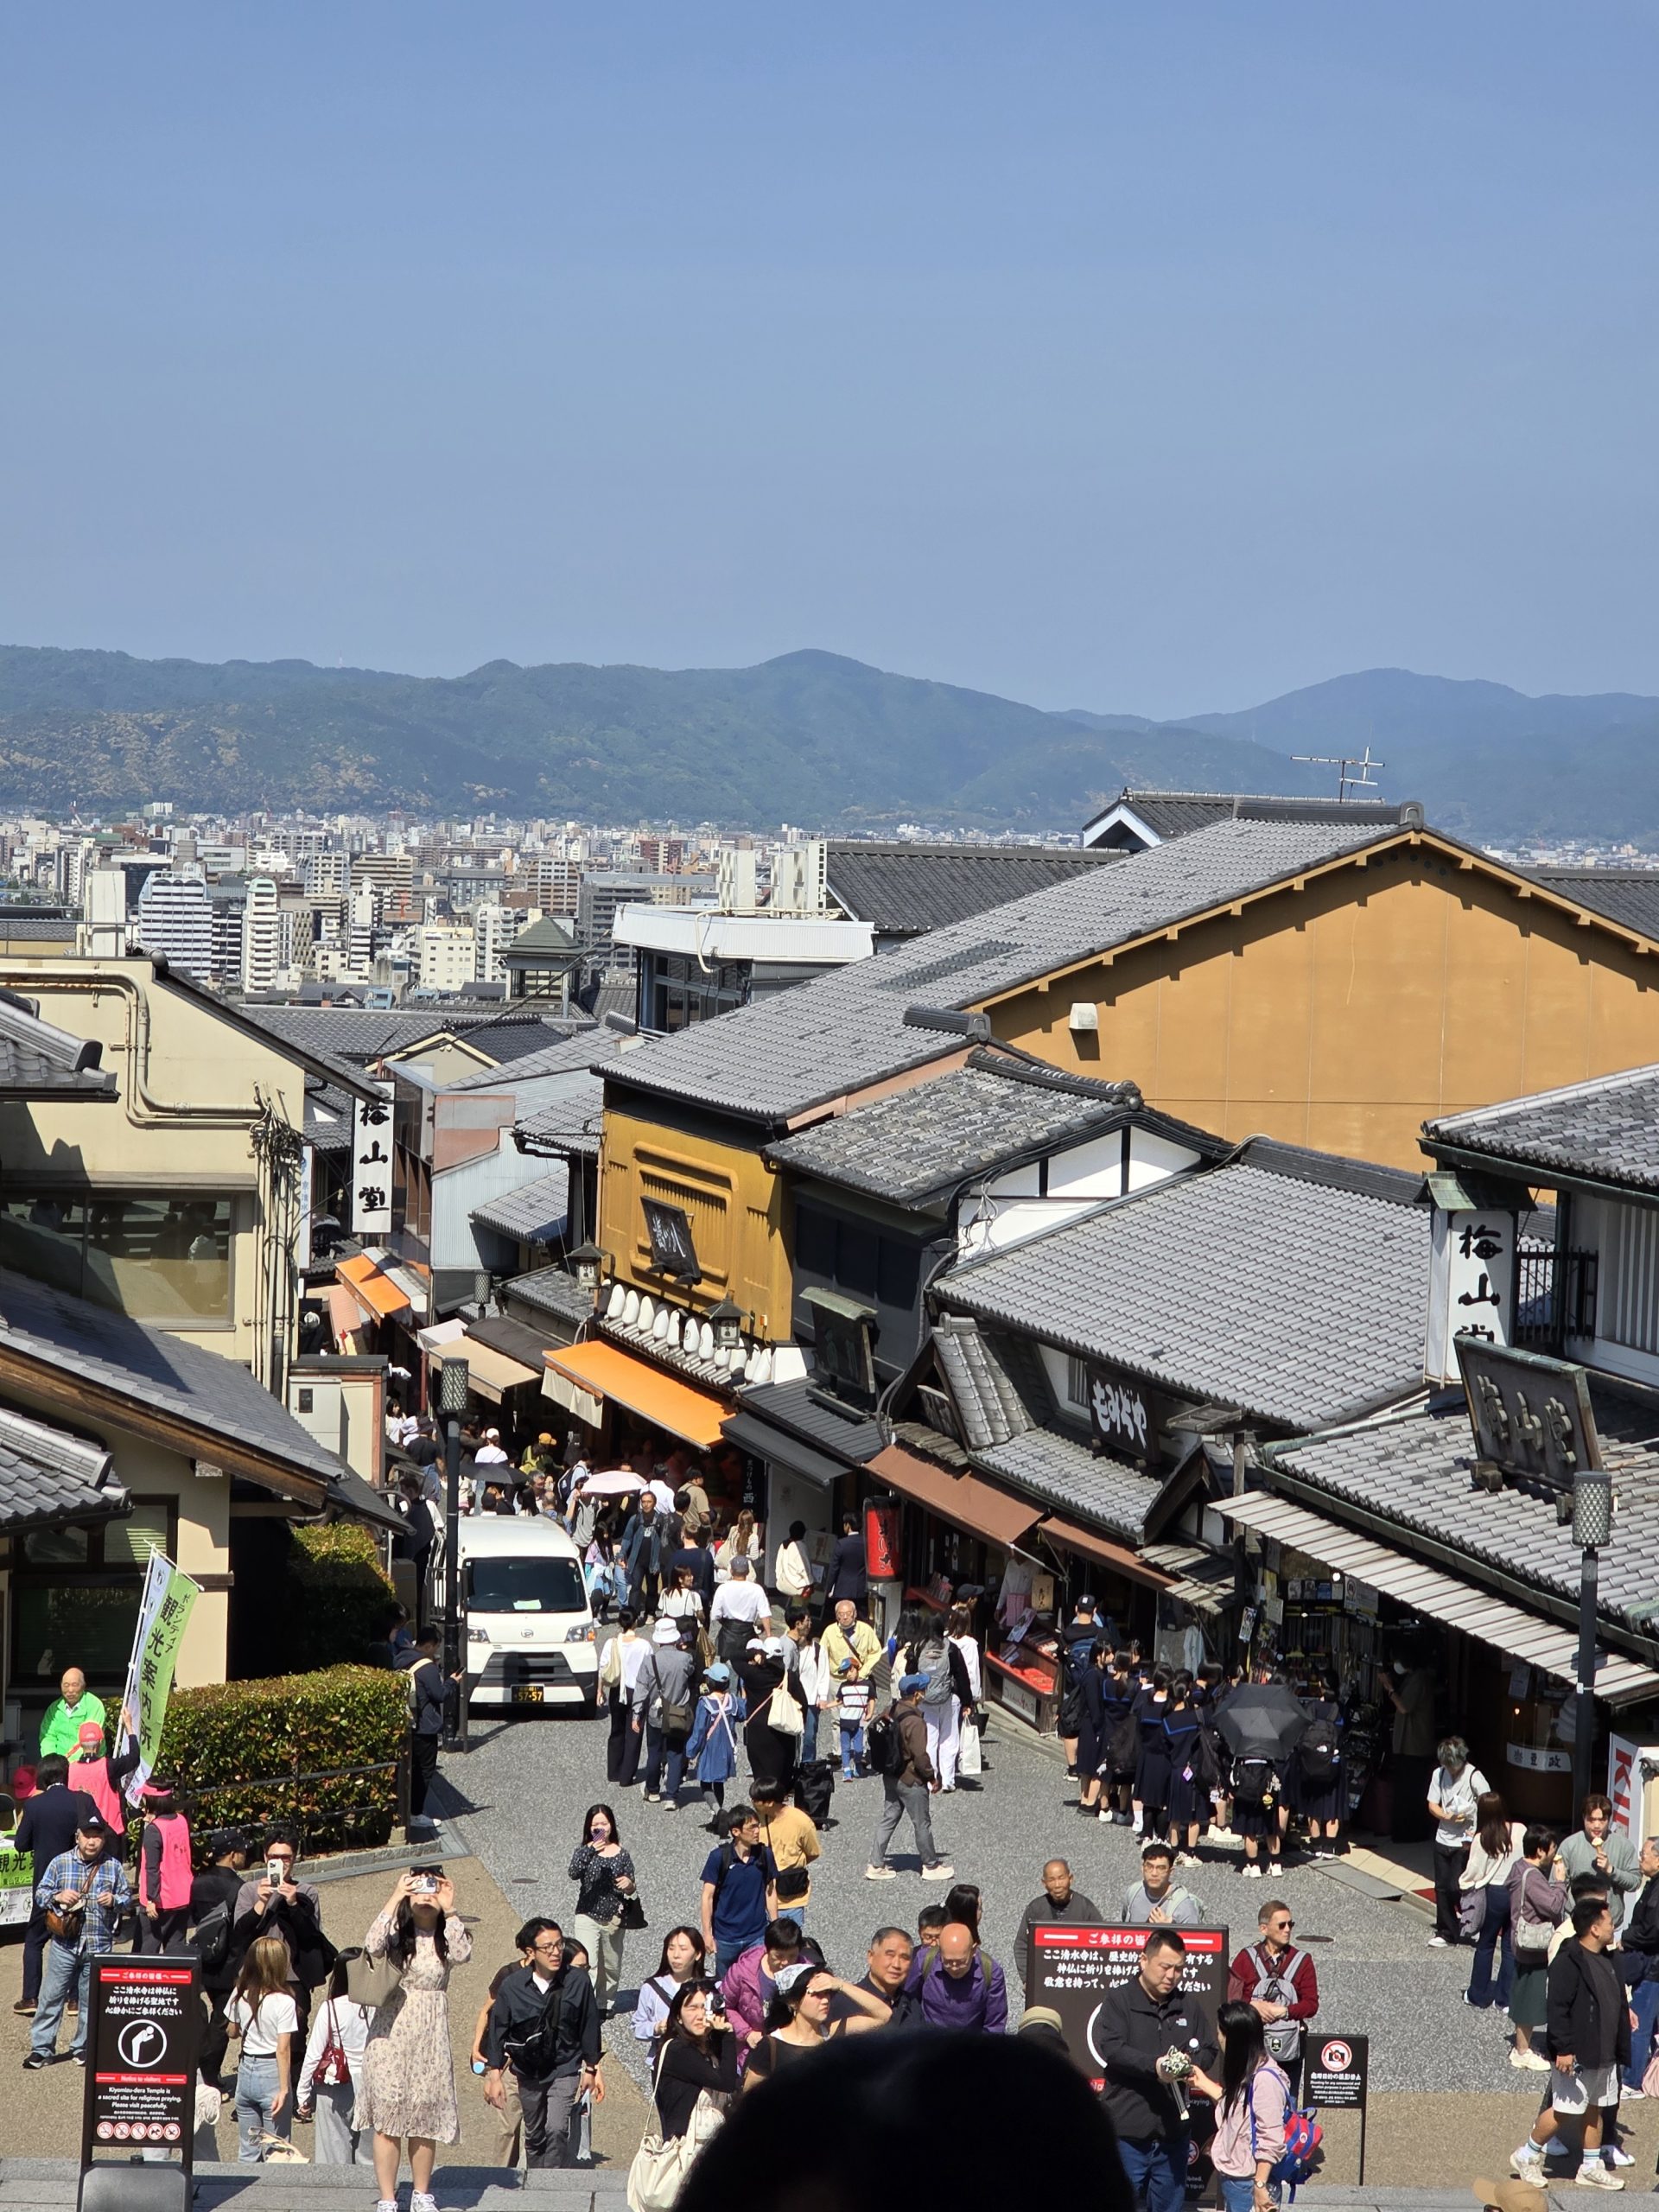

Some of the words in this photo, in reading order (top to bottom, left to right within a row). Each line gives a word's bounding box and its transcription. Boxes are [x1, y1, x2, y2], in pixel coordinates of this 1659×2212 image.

[164, 1593, 189, 1653] ボランティア
[141, 1594, 179, 1751] 観光案内所
[1530, 1752, 1561, 1768] 豆政
[1089, 1933, 1147, 1946] ご参拝の皆
[113, 1986, 176, 1995] ここ清水寺は神仏に
[109, 1995, 179, 2005] 祈りを捧げる聖地です
[105, 2006, 182, 2016] 心静かにご参拝ください
